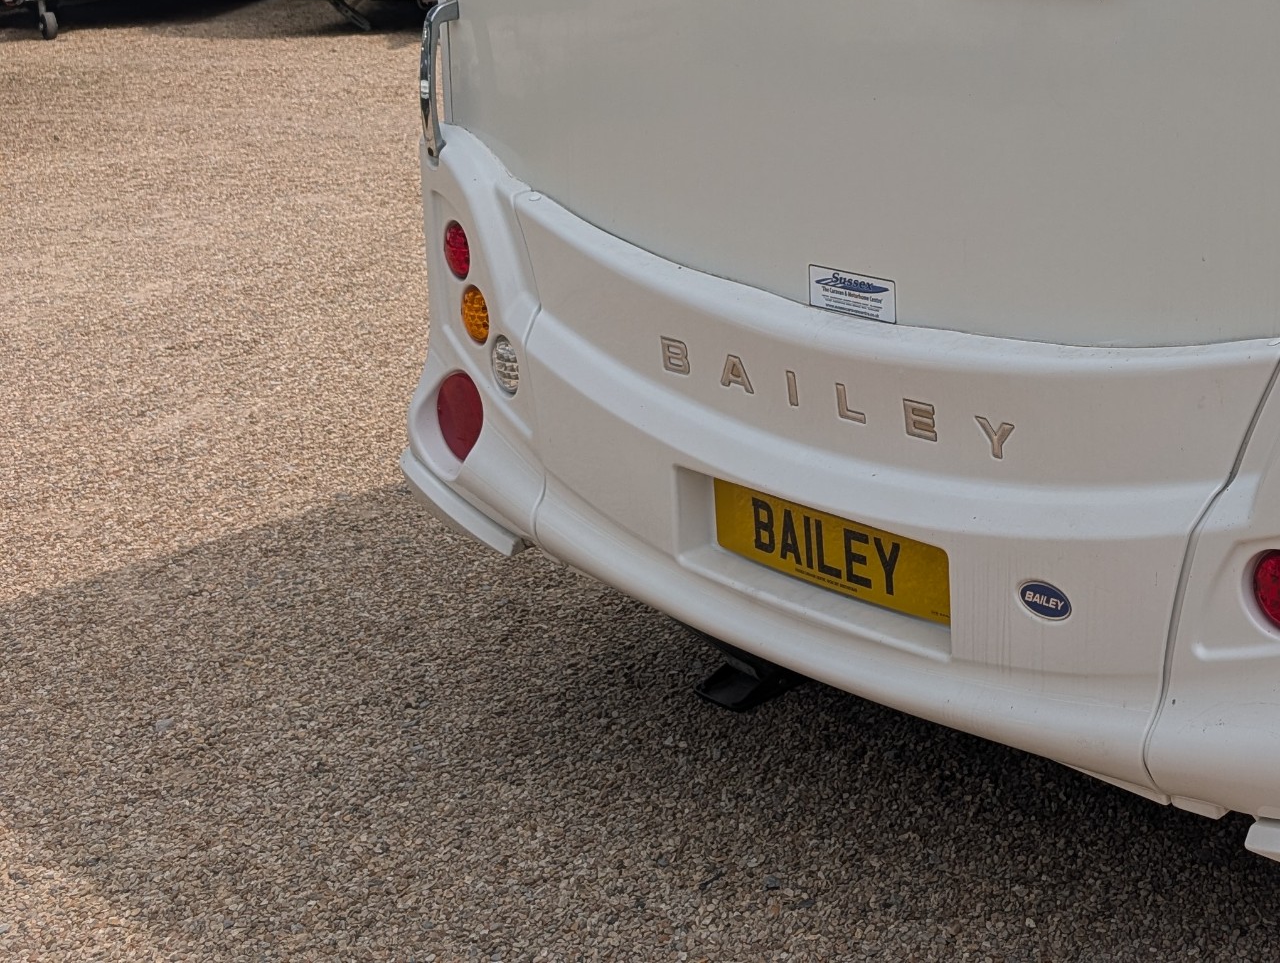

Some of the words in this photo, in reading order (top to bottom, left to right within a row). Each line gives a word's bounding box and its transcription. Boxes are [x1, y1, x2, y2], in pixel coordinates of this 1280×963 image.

[831, 272, 874, 290] Sussex
[660, 336, 1015, 459] BAILEY
[751, 497, 900, 596] BAILEY
[1025, 591, 1064, 610] BAILEY
